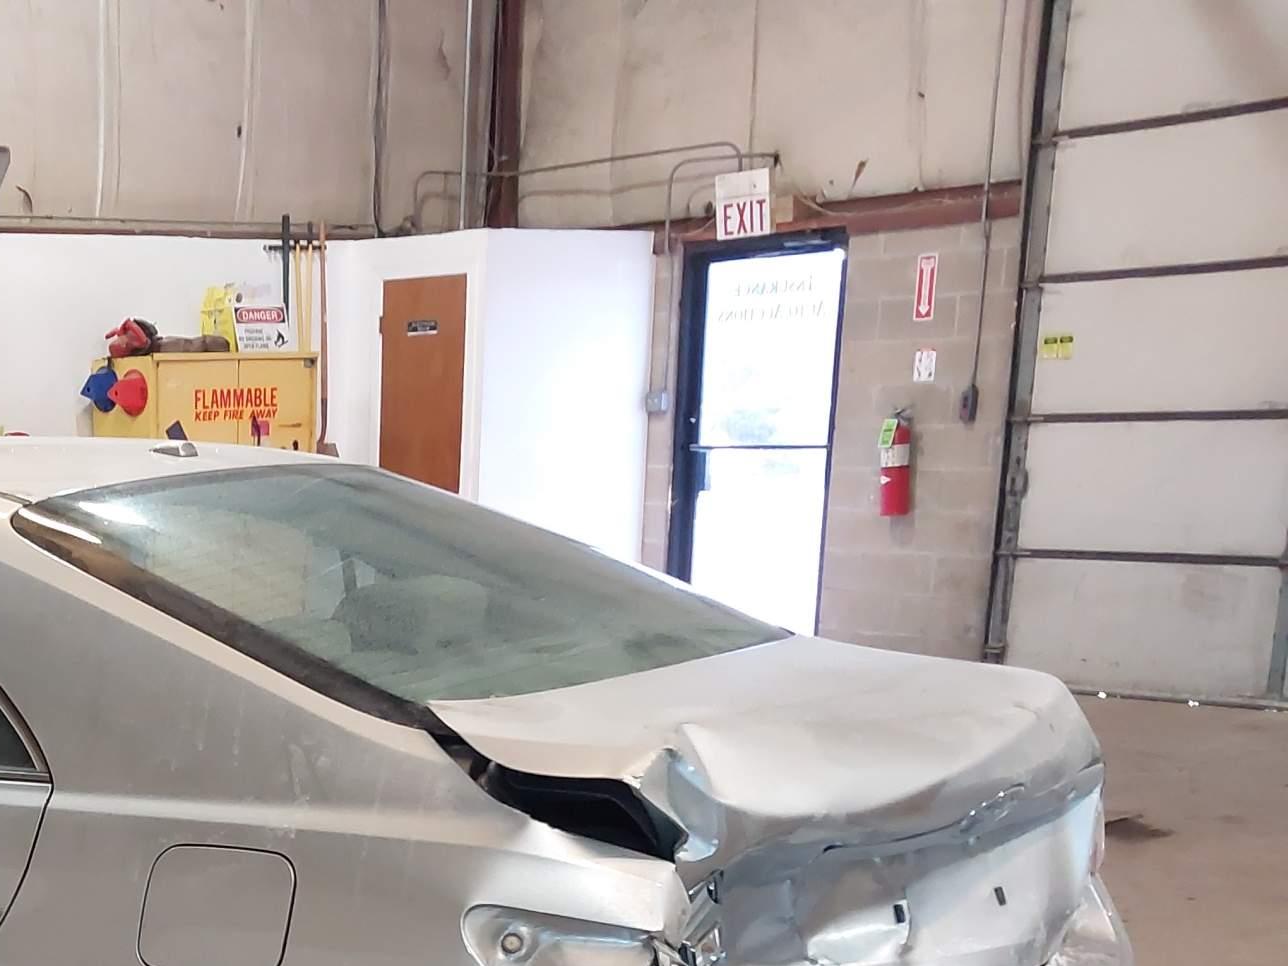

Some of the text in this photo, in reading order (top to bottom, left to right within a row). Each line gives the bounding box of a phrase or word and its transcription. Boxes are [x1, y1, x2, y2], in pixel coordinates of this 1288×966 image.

[723, 199, 766, 236] EXIT
[241, 309, 279, 321] DANGER
[194, 387, 278, 409] FLAMMABLE
[194, 408, 278, 422] KEEP FIRE AWAY
